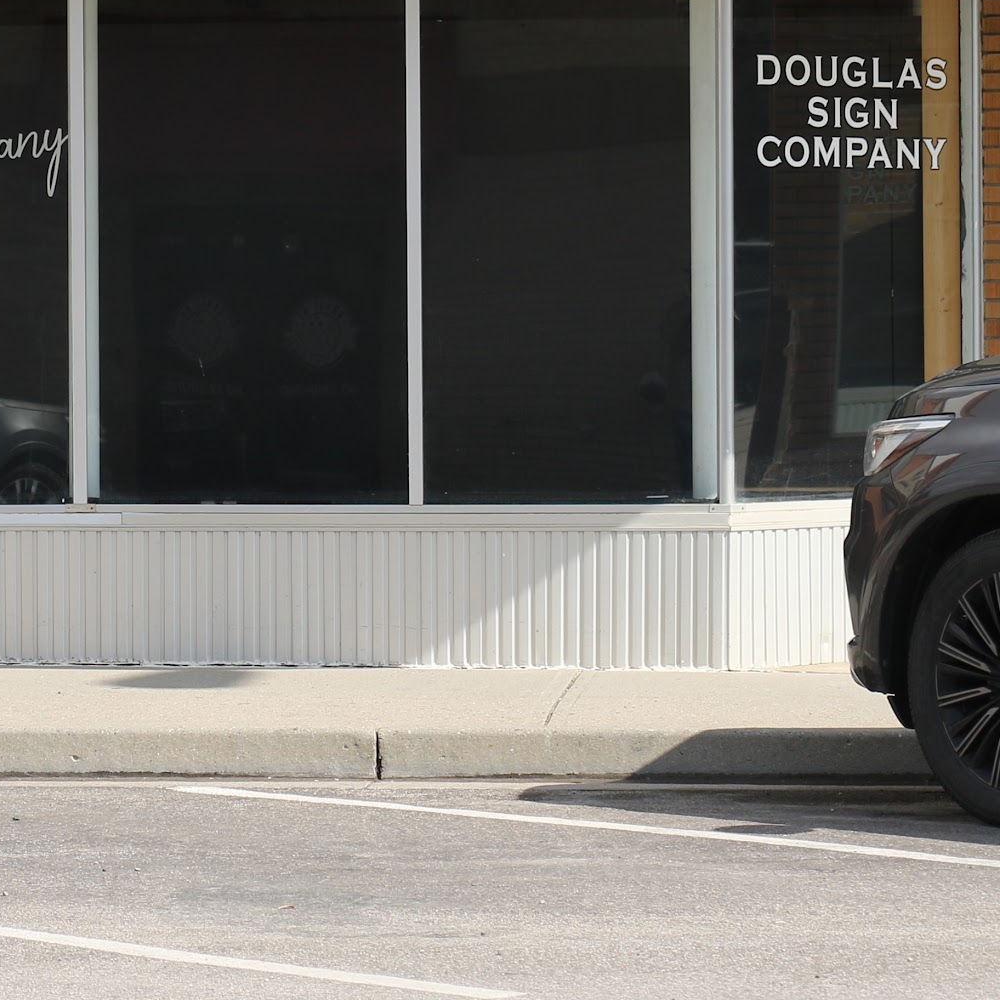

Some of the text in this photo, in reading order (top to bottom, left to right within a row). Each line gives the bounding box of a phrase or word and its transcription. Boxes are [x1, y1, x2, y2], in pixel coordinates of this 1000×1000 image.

[756, 54, 948, 90] DOUGLAS
[807, 96, 898, 129] SIGN
[756, 136, 948, 170] COMPANY
